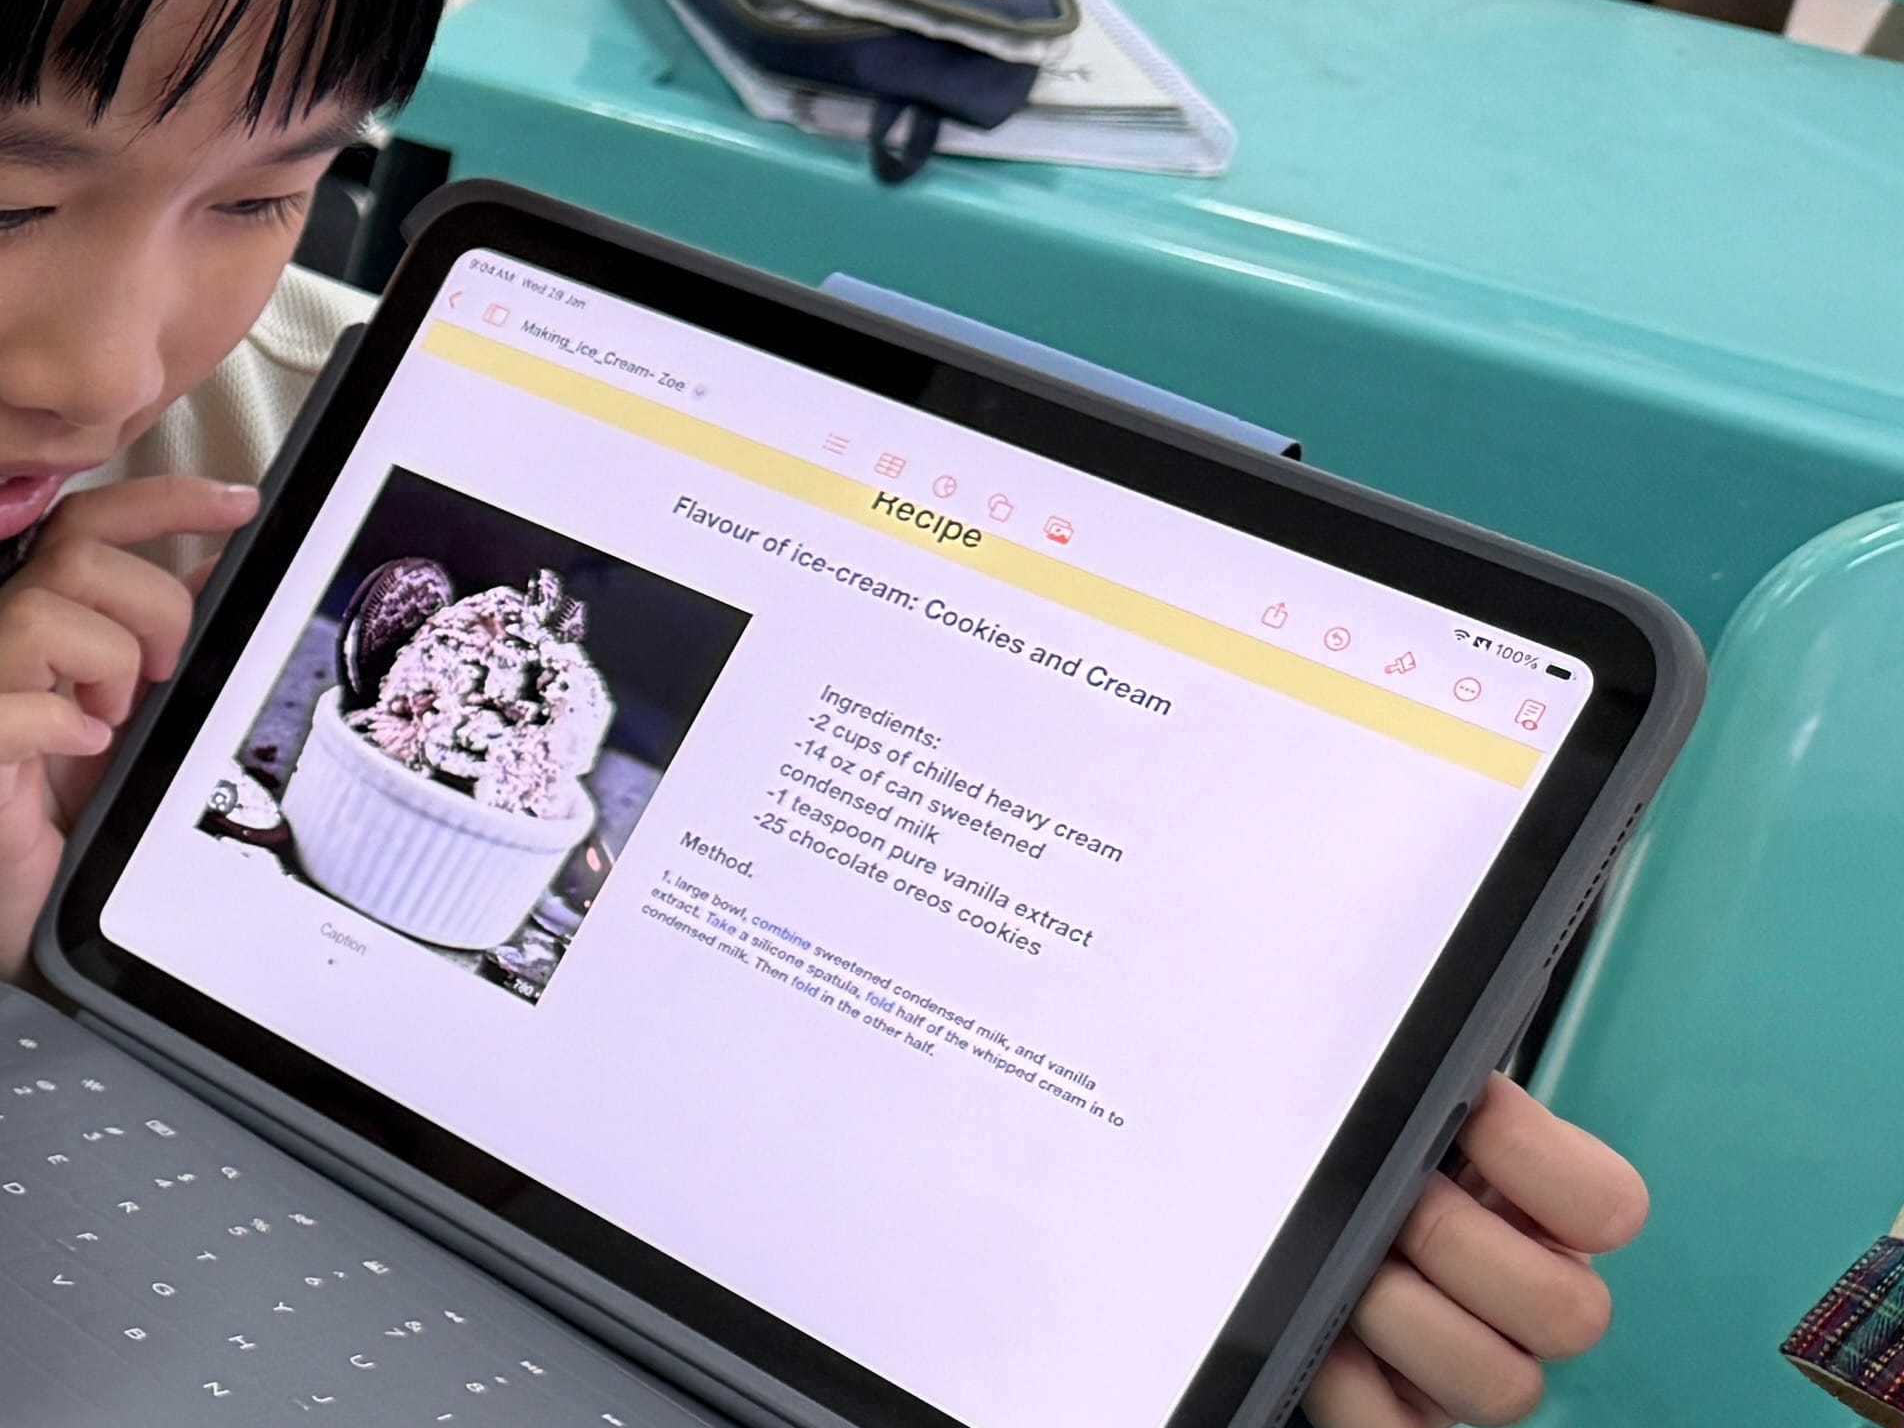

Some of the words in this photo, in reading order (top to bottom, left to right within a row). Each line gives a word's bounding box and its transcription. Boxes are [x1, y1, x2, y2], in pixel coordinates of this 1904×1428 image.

[564, 293, 587, 310] Jan
[657, 372, 687, 393] Zoe
[672, 495, 761, 544] Flavour
[762, 536, 792, 557] of
[790, 543, 920, 611] ice-cream:
[924, 598, 1026, 654] Cookies
[1029, 646, 1084, 677] and
[1086, 665, 1172, 716] Cream
[1495, 644, 1540, 670] 100%
[820, 684, 942, 750] Ingredients:
[808, 713, 831, 732] -2
[832, 724, 883, 755] cups
[886, 749, 913, 767] of
[912, 760, 985, 800] chilled
[984, 788, 1052, 831] heavy
[1053, 823, 1124, 863] cream
[779, 763, 895, 822] condensed
[893, 815, 941, 845] milk
[794, 739, 829, 761] -14
[830, 755, 857, 776] oz
[859, 768, 886, 786] of
[884, 780, 924, 806] can
[927, 799, 1047, 860] sweetened
[766, 788, 789, 805] -1
[791, 795, 886, 852] teaspoon
[886, 844, 937, 875] pure
[943, 867, 1010, 909] vanilla
[1014, 903, 1094, 948] extract
[753, 812, 788, 835] -25
[788, 829, 889, 884] chocolate
[893, 878, 953, 914] oreos
[957, 908, 1042, 956] cookies
[319, 921, 368, 957] Caption
[641, 904, 718, 947] condensed
[754, 956, 789, 983] Then
[790, 975, 821, 998] fold
[819, 990, 835, 1006] in
[836, 999, 861, 1019] the
[862, 1014, 904, 1039] other
[903, 1031, 936, 1057] half.
[674, 875, 710, 901] large
[751, 916, 812, 951] combine
[813, 946, 893, 990] sweetened
[892, 985, 976, 1031] condensed
[975, 1026, 1011, 1052] milk,
[1014, 1045, 1047, 1066] and
[1047, 1060, 1097, 1091] vanilla
[706, 910, 738, 936] Take
[738, 930, 750, 942] a
[750, 936, 805, 969] silicone
[864, 990, 897, 1014] fold
[895, 1005, 927, 1028] half
[925, 1023, 945, 1037] of
[944, 1030, 969, 1050] the
[972, 1045, 1038, 1084] whipped
[1038, 1079, 1087, 1109] cream
[1088, 1100, 1105, 1118] in
[1107, 1110, 1125, 1127] to
[47, 1154, 69, 1165] E
[2, 1182, 26, 1195] D
[117, 1201, 140, 1214] R
[76, 1232, 99, 1241] F
[227, 1226, 248, 1236] 5
[196, 1251, 217, 1260] T
[52, 1274, 75, 1286] V
[152, 1282, 176, 1297] G
[273, 1301, 294, 1312] Y
[123, 1327, 147, 1340] B
[384, 1327, 406, 1337] 7
[227, 1334, 256, 1350] H
[349, 1354, 375, 1369] U
[202, 1381, 230, 1397] N
[311, 1395, 334, 1404] J
